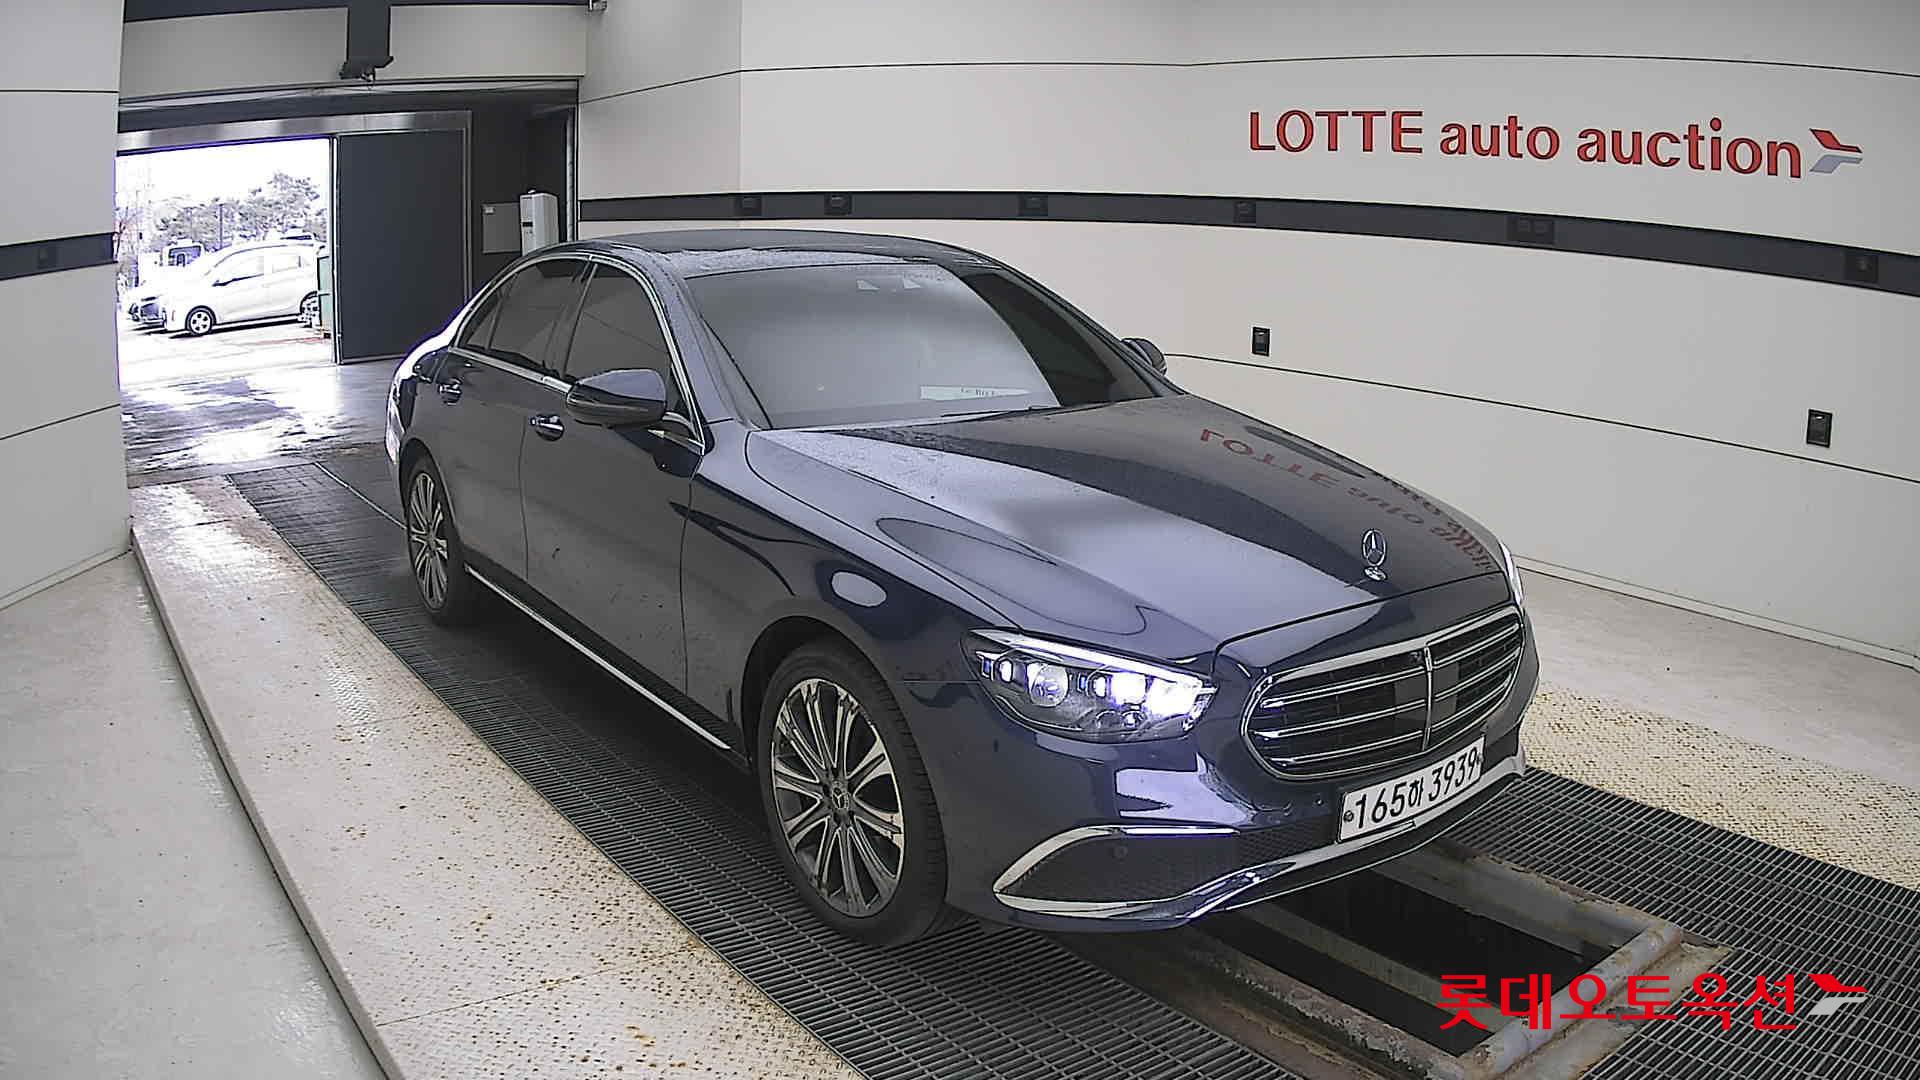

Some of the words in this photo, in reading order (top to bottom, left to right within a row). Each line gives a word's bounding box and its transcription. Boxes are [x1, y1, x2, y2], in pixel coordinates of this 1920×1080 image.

[1249, 110, 1424, 153] LOTTE
[1440, 115, 1560, 160] auto
[1577, 117, 1802, 178] auction
[1355, 777, 1424, 829] 165하
[1428, 746, 1478, 801] 3939
